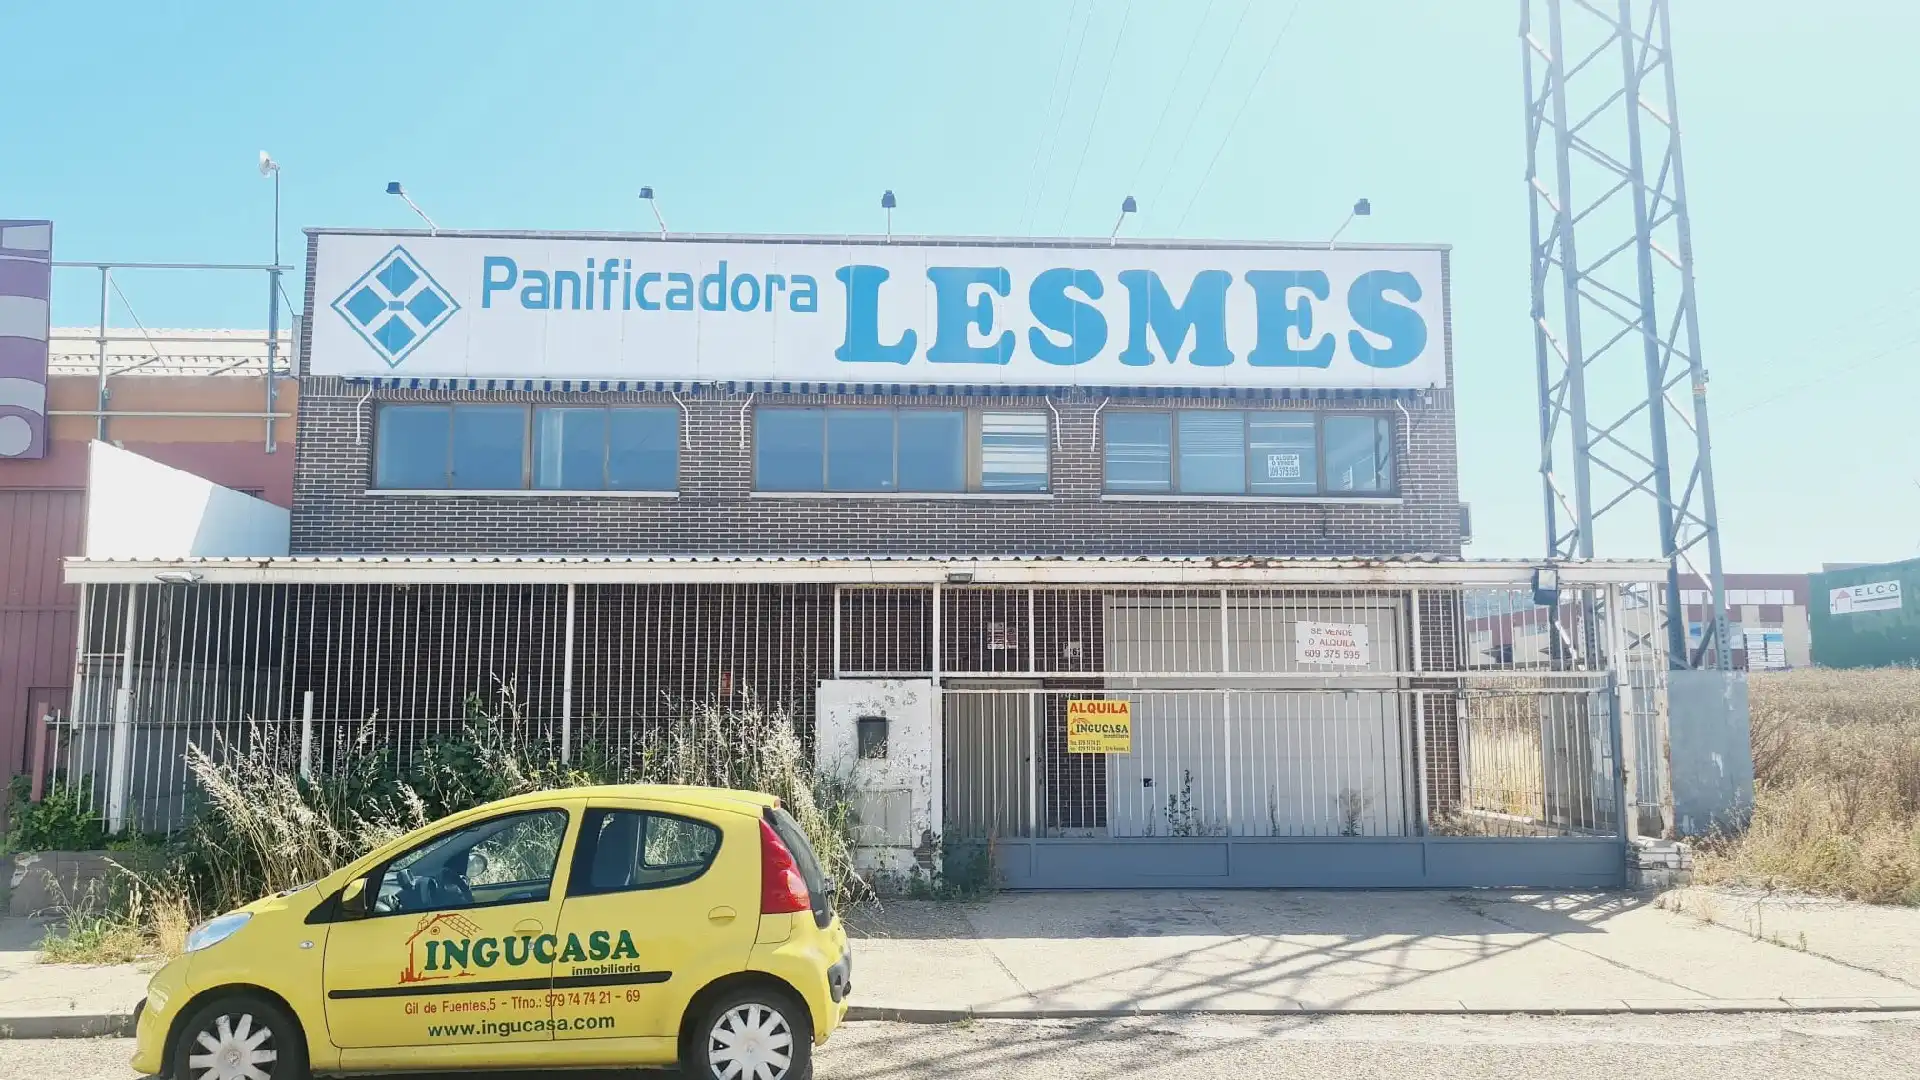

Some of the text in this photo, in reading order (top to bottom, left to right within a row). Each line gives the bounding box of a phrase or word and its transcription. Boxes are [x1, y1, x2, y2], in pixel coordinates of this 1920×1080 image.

[481, 256, 1428, 369] Panificadora LESMES
[1854, 583, 1898, 596] ELCO
[1311, 627, 1353, 637] SE VENDE
[1308, 638, 1356, 648] O ALQUILA
[1304, 649, 1361, 660] 609 375 595
[1070, 702, 1128, 714] ALQUILA
[1076, 724, 1129, 733] INGUCASA
[424, 929, 640, 971] INGUCASA
[571, 962, 641, 976] inmobiliaria
[404, 1001, 419, 1015] Gil
[423, 1001, 437, 1014] de
[545, 993, 565, 1008] 979
[568, 992, 580, 1006] 74
[583, 991, 595, 1005] 74
[599, 990, 611, 1004] 21
[626, 989, 641, 1003] 69
[427, 1015, 616, 1038] www.ingucasa.com
